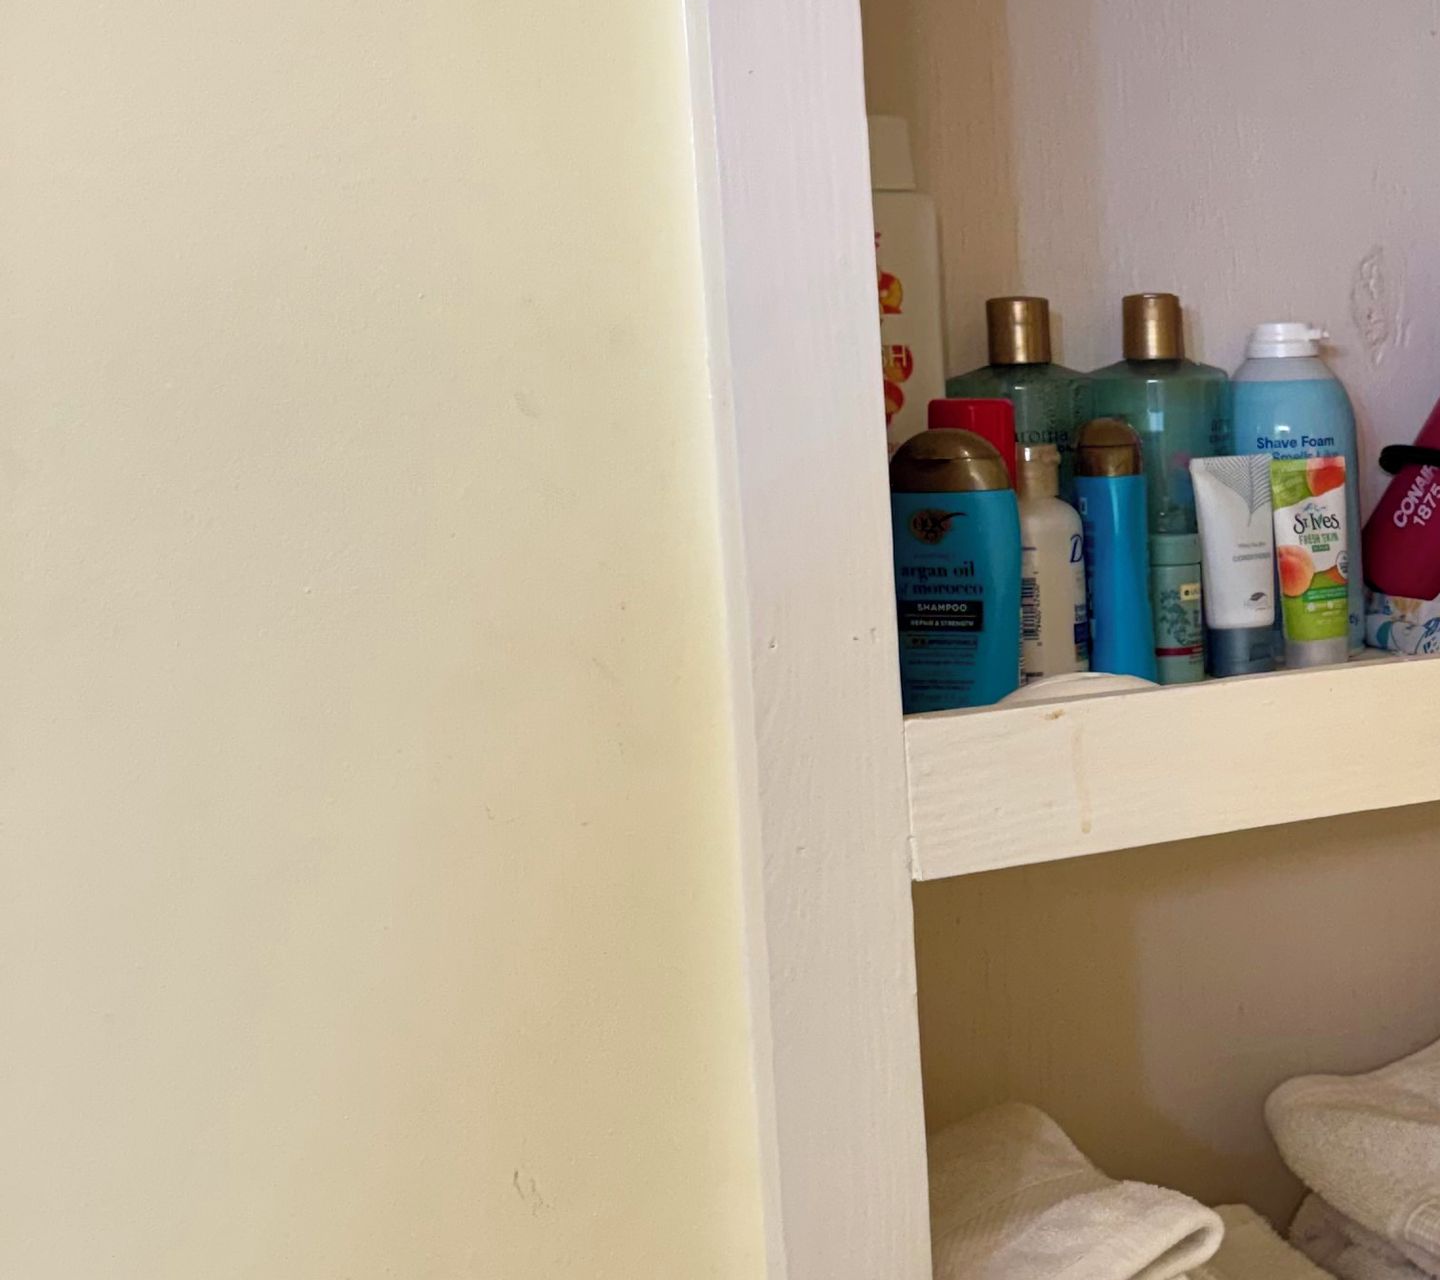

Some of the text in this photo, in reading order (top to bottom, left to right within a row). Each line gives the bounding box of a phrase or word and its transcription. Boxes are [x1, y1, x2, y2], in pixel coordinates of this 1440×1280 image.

[1256, 435, 1335, 450] Shave Foam
[901, 560, 975, 582] argan oil
[917, 603, 968, 612] SHAMPOO
